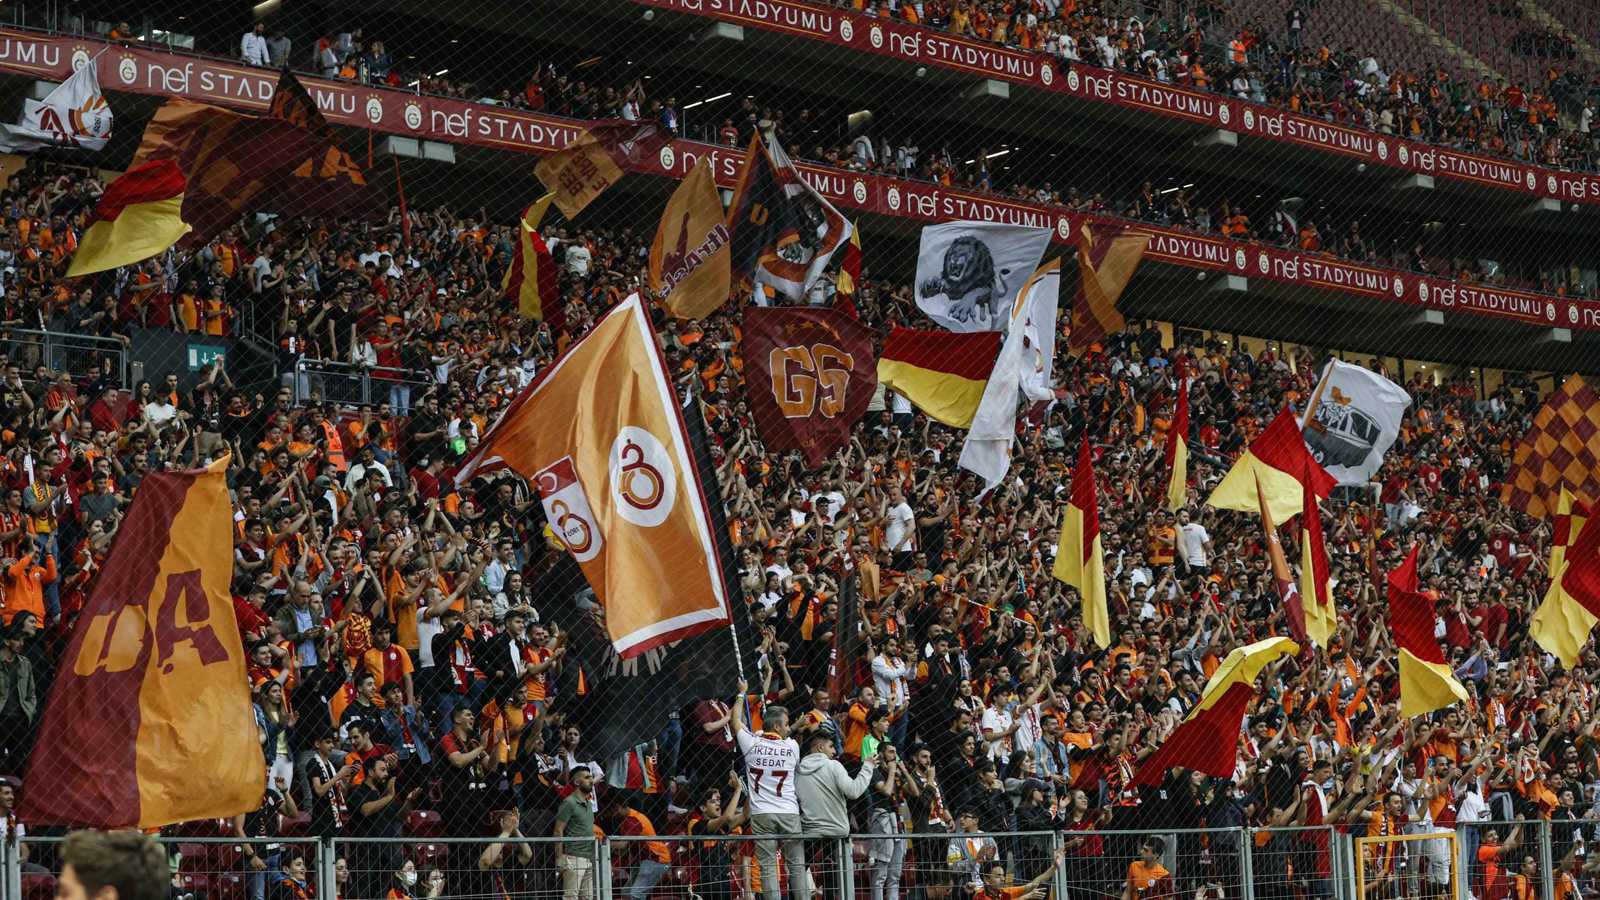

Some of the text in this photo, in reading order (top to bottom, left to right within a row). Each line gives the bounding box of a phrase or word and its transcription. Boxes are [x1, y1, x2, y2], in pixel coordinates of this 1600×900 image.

[890, 32, 1033, 76] nef STADYUMU
[148, 63, 193, 94] nef
[201, 72, 356, 113] STADMU
[1085, 74, 1213, 116] nef STADYUMU
[432, 109, 577, 145] nef STADYU
[1259, 113, 1373, 153] nef STADYUMU
[1413, 149, 1522, 183] nef STADYUMU
[1562, 178, 1587, 198] nef
[907, 190, 1051, 229] nef STADYUMU
[1275, 256, 1388, 291] nef STADYUMU
[1433, 285, 1541, 315] nef STADYUMU
[770, 343, 854, 418] GS
[756, 758, 786, 768] SEDAT
[750, 768, 788, 797] 77
